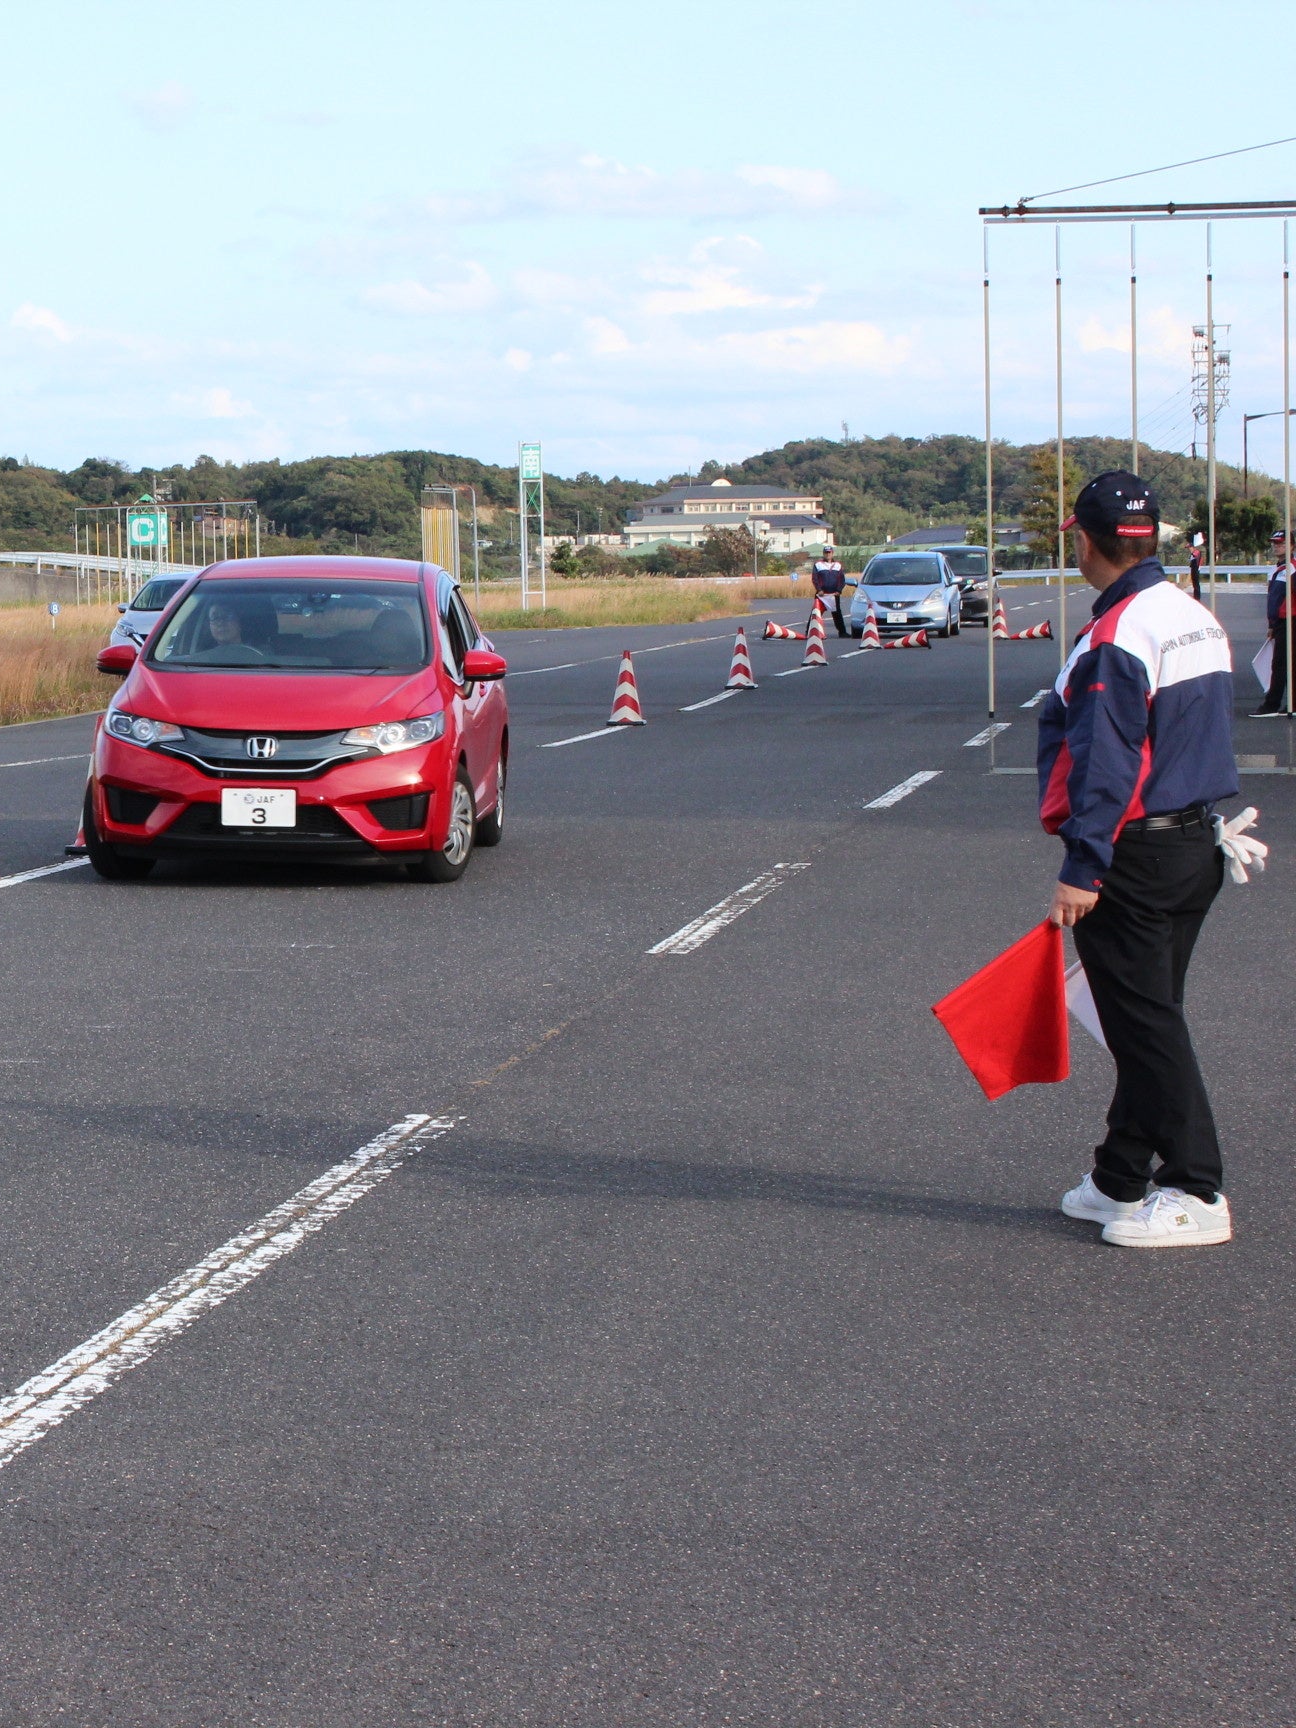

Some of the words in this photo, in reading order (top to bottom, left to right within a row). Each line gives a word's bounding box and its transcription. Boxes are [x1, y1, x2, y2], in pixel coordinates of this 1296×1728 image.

[1126, 500, 1146, 510] JAF
[132, 518, 154, 542] C
[52, 604, 59, 614] 8
[257, 795, 275, 804] JAF
[252, 807, 267, 824] 3
